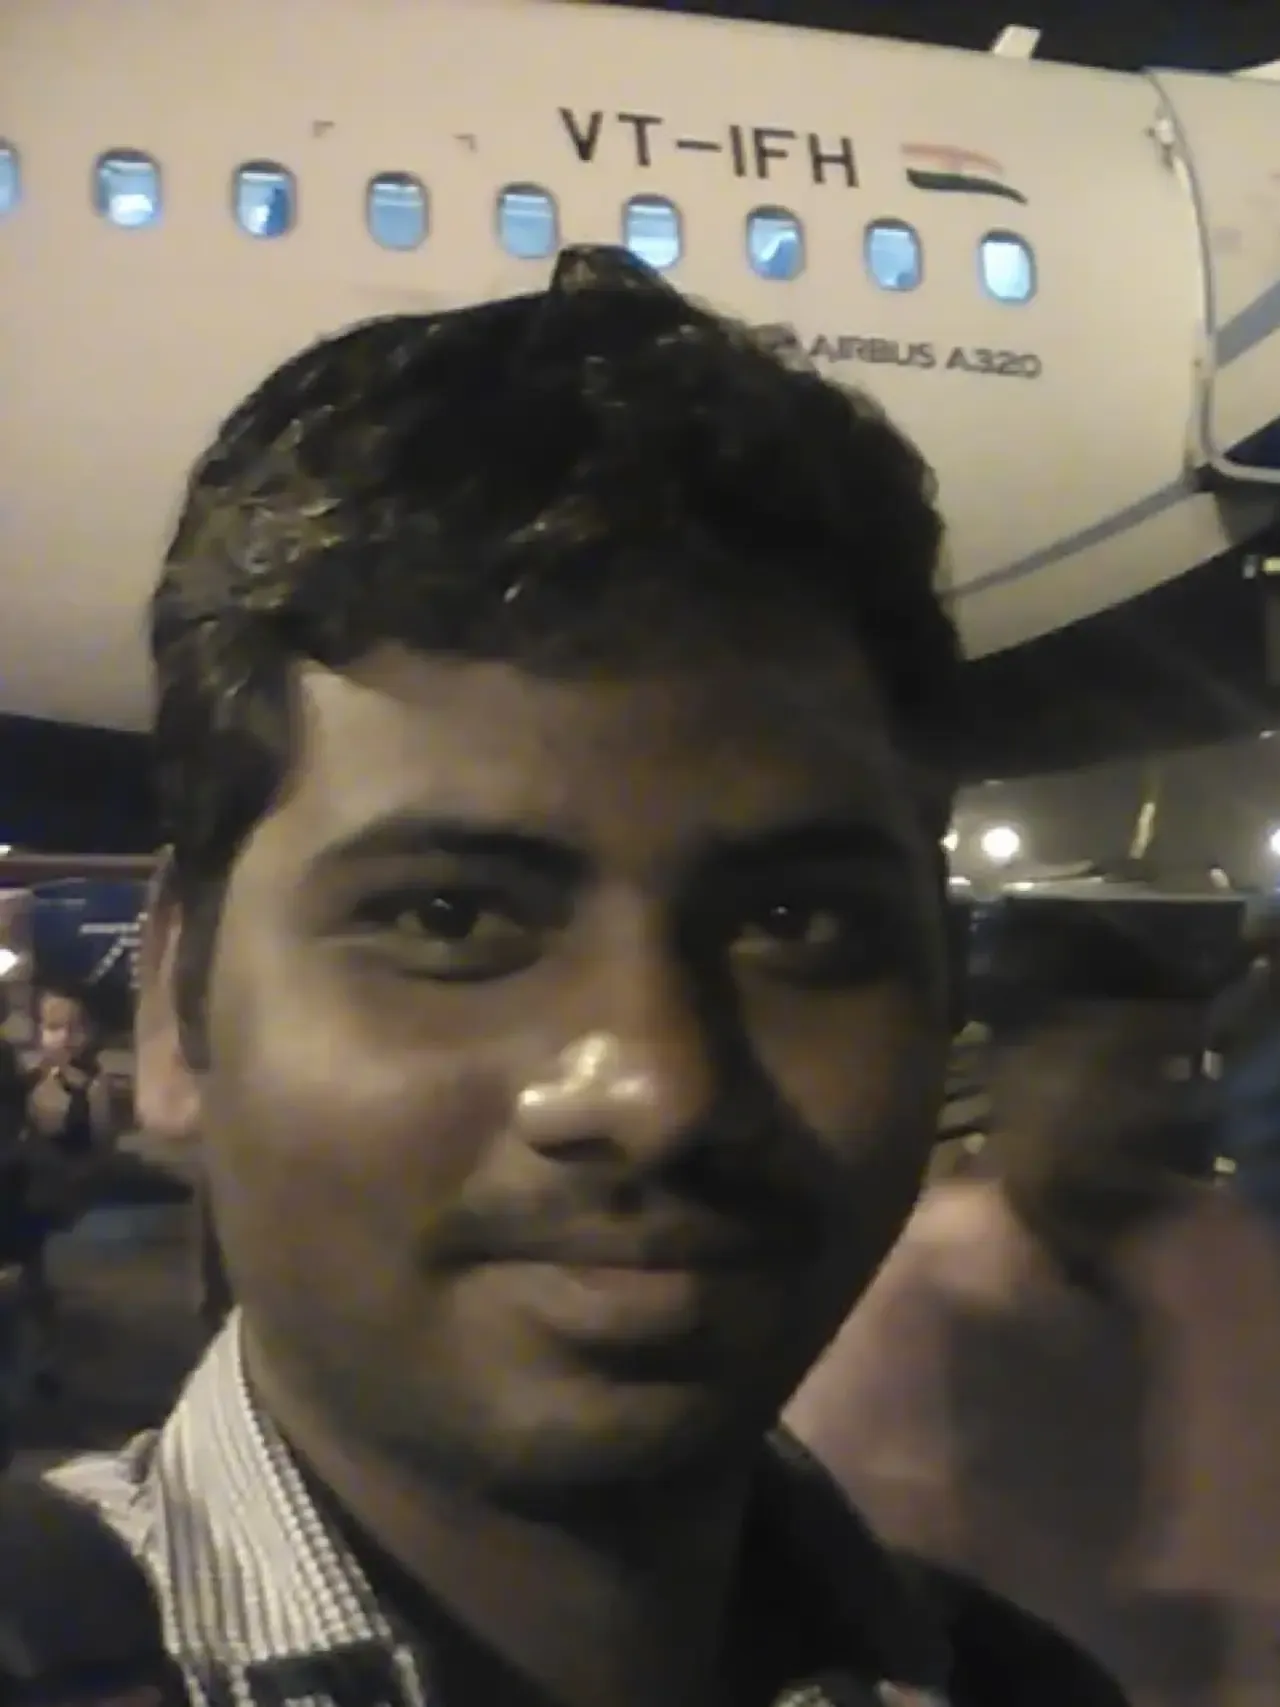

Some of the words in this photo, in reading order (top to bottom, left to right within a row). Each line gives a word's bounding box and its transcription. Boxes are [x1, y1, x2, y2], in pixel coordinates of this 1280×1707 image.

[559, 106, 860, 188] VT-IFH
[809, 334, 936, 369] AIRBUS
[946, 346, 1042, 379] A320
